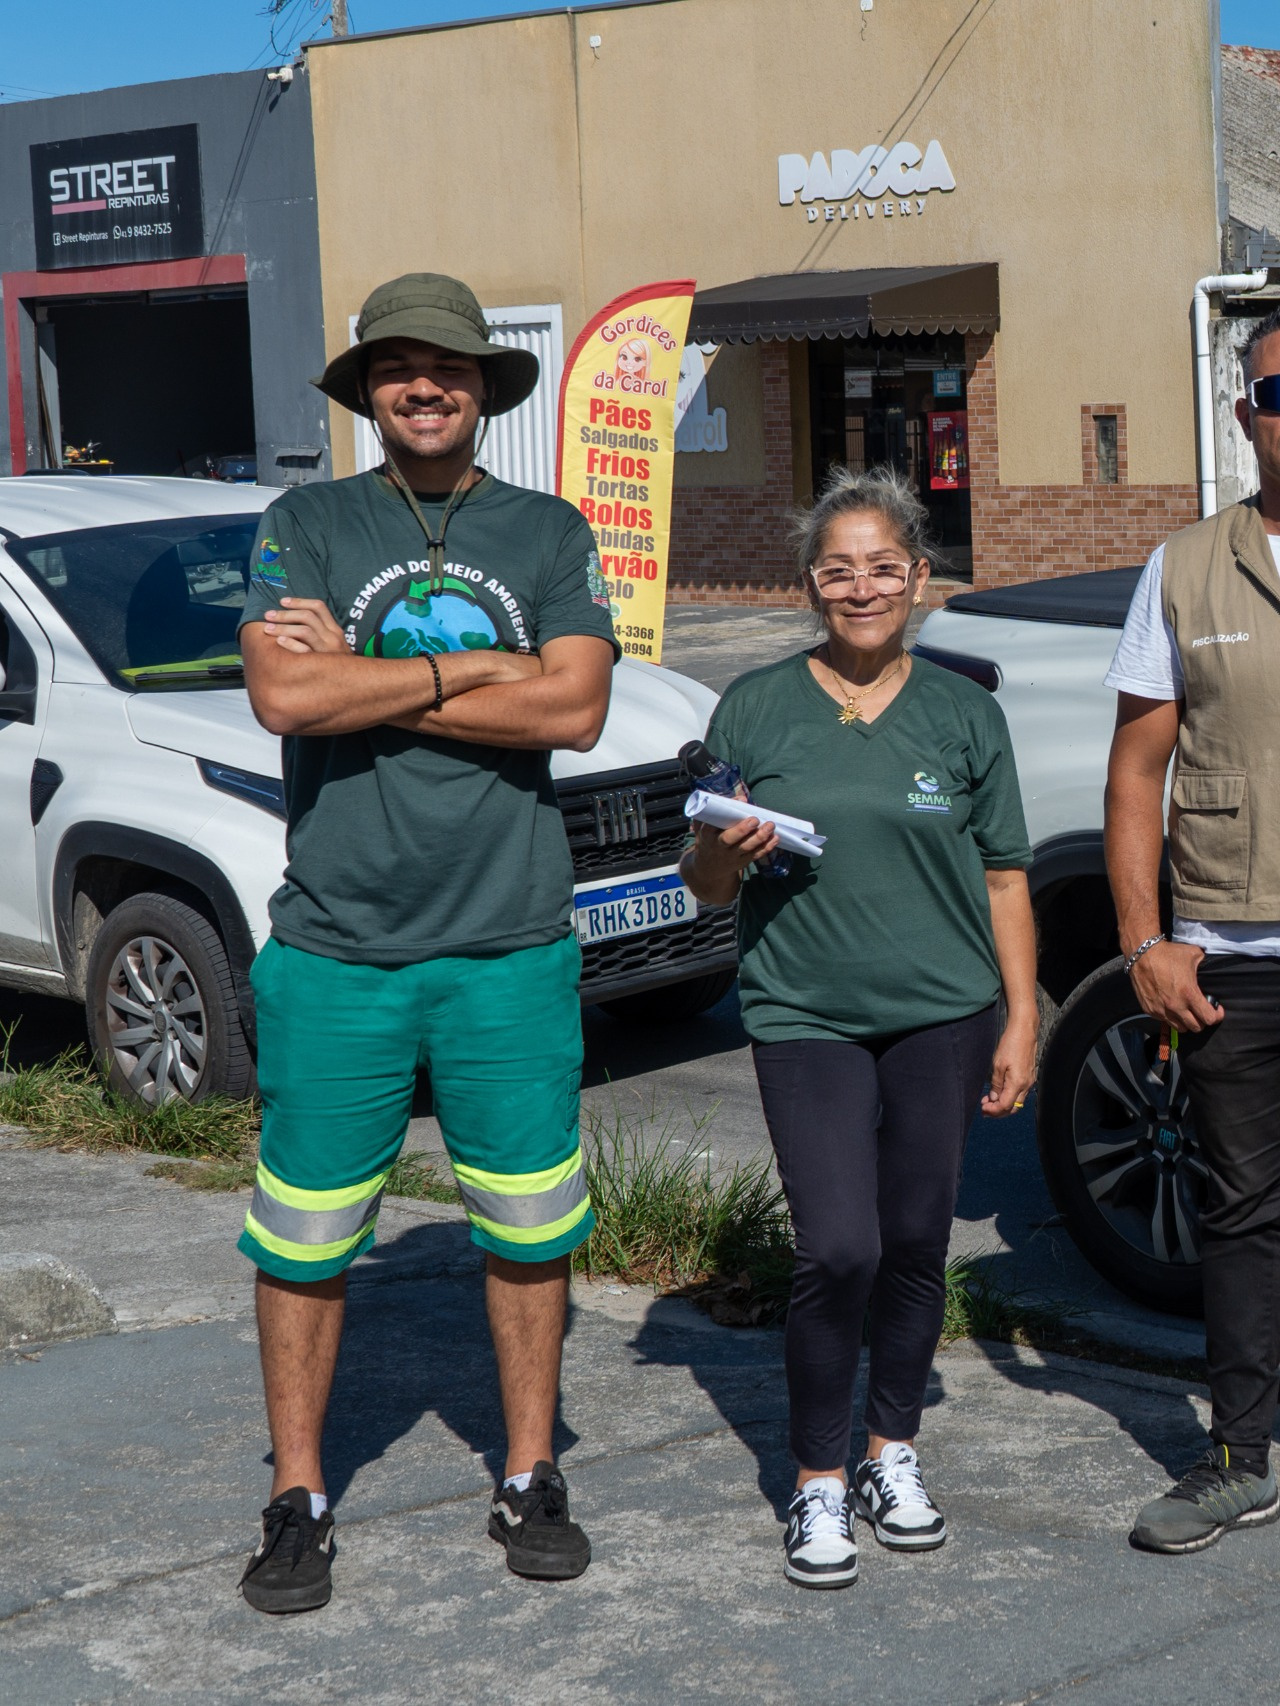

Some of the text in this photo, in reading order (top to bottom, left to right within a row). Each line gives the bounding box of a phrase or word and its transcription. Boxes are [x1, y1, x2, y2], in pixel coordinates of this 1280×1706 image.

[50, 155, 175, 202] STREET
[778, 140, 956, 204] PADOCA
[108, 192, 170, 210] REPINTURAS
[806, 199, 926, 223] DELIVERY
[61, 231, 109, 243] Street Repinturas
[601, 315, 677, 352] Gordices
[594, 372, 668, 397] da Carol
[589, 398, 652, 431] Pães
[580, 426, 659, 452] Salgados
[587, 448, 650, 480] Frios
[586, 476, 649, 502] Tortas
[580, 498, 653, 530] Bolos
[592, 528, 655, 552] ebidas
[602, 551, 658, 581] rvão
[349, 564, 406, 620] SEMANA
[407, 560, 431, 573] DO
[443, 562, 483, 583] MEIO
[607, 579, 634, 599] elo
[614, 625, 654, 640] 4-3368
[1192, 631, 1250, 648] FISCALIZAÇÃO
[907, 792, 952, 807] SEMMA
[626, 886, 646, 896] BRASIL
[588, 890, 686, 938] RHK3D88
